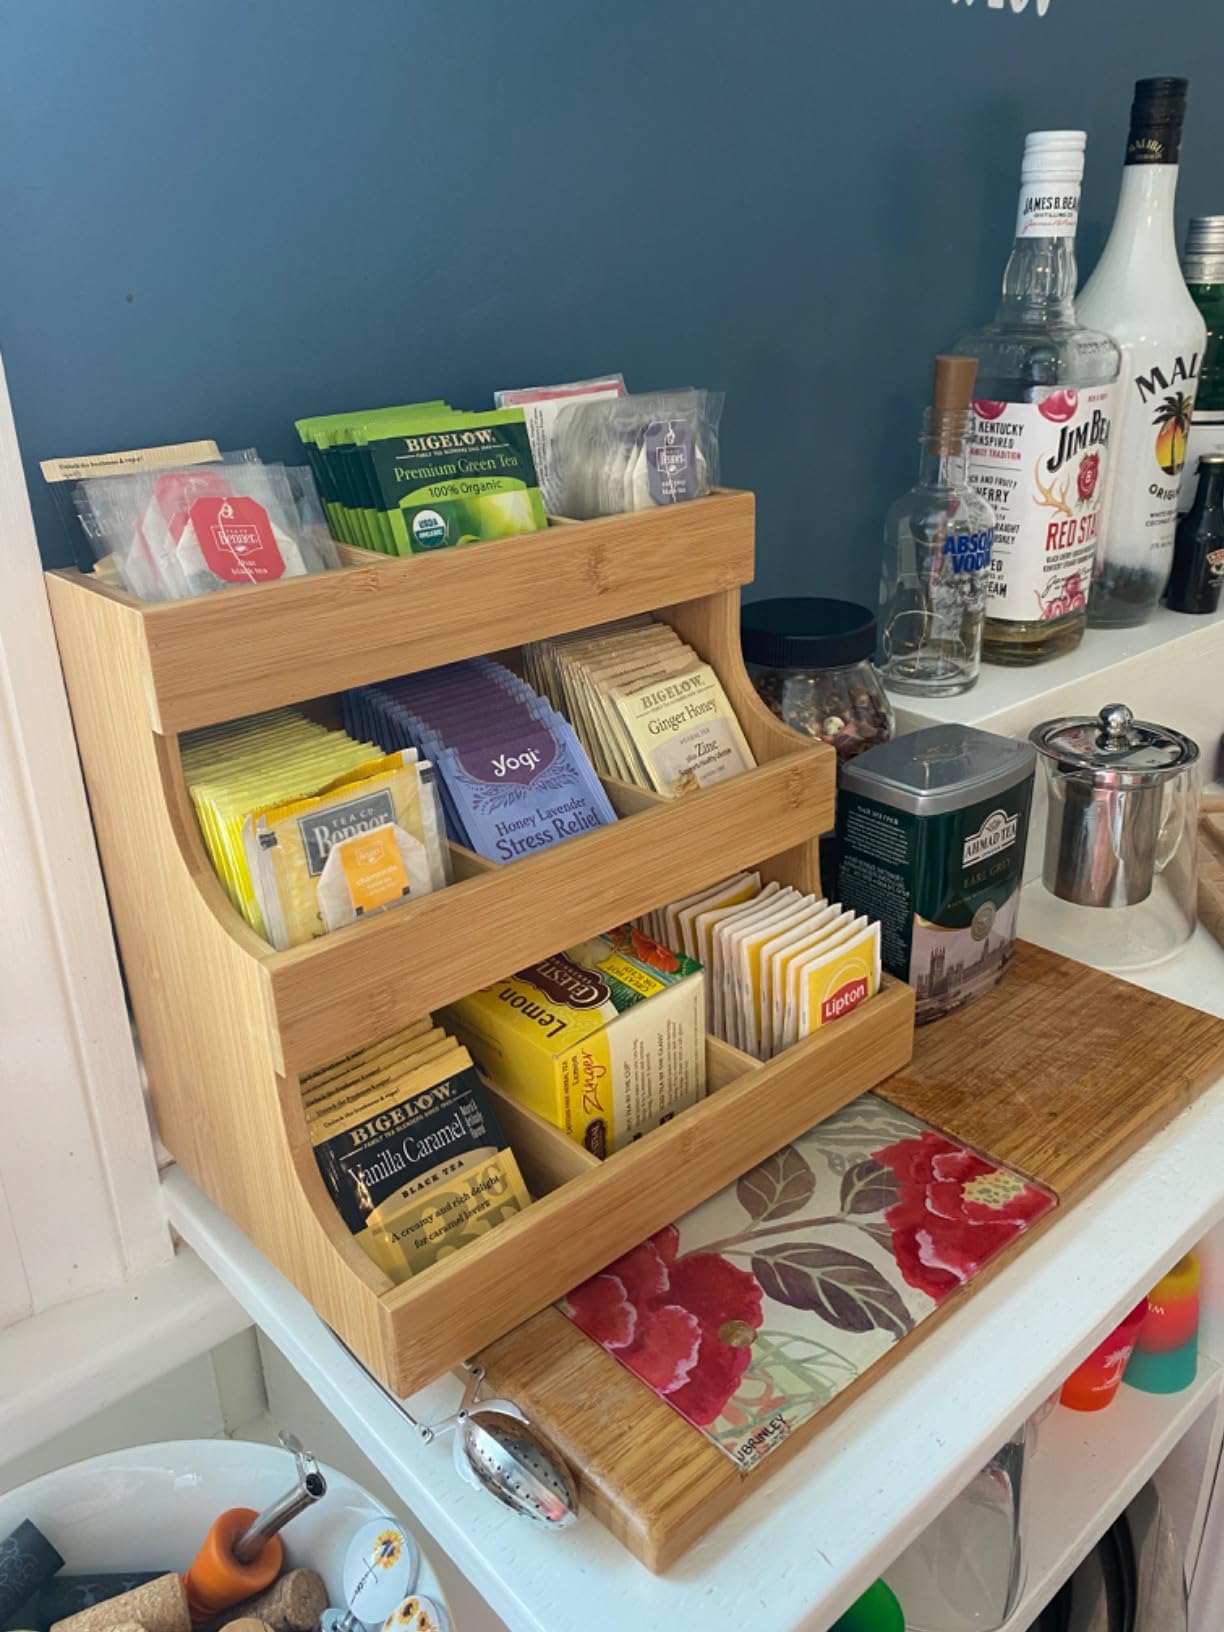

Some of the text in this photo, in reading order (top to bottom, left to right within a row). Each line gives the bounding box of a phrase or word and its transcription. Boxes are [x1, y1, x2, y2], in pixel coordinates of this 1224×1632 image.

[405, 429, 493, 452] BIGELOW
[978, 421, 1025, 437] KENTUCKY
[1046, 421, 1090, 474] JIM
[393, 453, 518, 482] Premium Green Tea
[428, 479, 503, 498] 100% Organic
[976, 487, 1010, 503] HERRY
[418, 518, 438, 529] USDA
[1045, 519, 1077, 551] RED
[640, 675, 703, 710] BIGELOW
[648, 711, 687, 735] Ginger
[685, 698, 717, 720] Honey
[491, 748, 541, 777] yogi
[694, 740, 718, 757] Zinc
[495, 797, 587, 837] Honey Lavender
[495, 806, 602, 861] Stress Relief
[965, 831, 1000, 857] AHMAD
[1000, 822, 1016, 838] TEA
[963, 870, 987, 888] EARL
[605, 963, 624, 977] HOT
[623, 973, 649, 992] GREAT
[498, 987, 568, 1038] Lemon
[825, 984, 865, 1016] Lipton
[581, 1047, 607, 1115] Zinger
[349, 1081, 450, 1146] BIGELOW
[347, 1149, 407, 1187] Vanilla
[402, 1112, 467, 1162] Caramel
[401, 1160, 465, 1198] BLACK TEA
[391, 1175, 501, 1244] A creamy and rich delight
[413, 1200, 491, 1249] for caramel lovers
